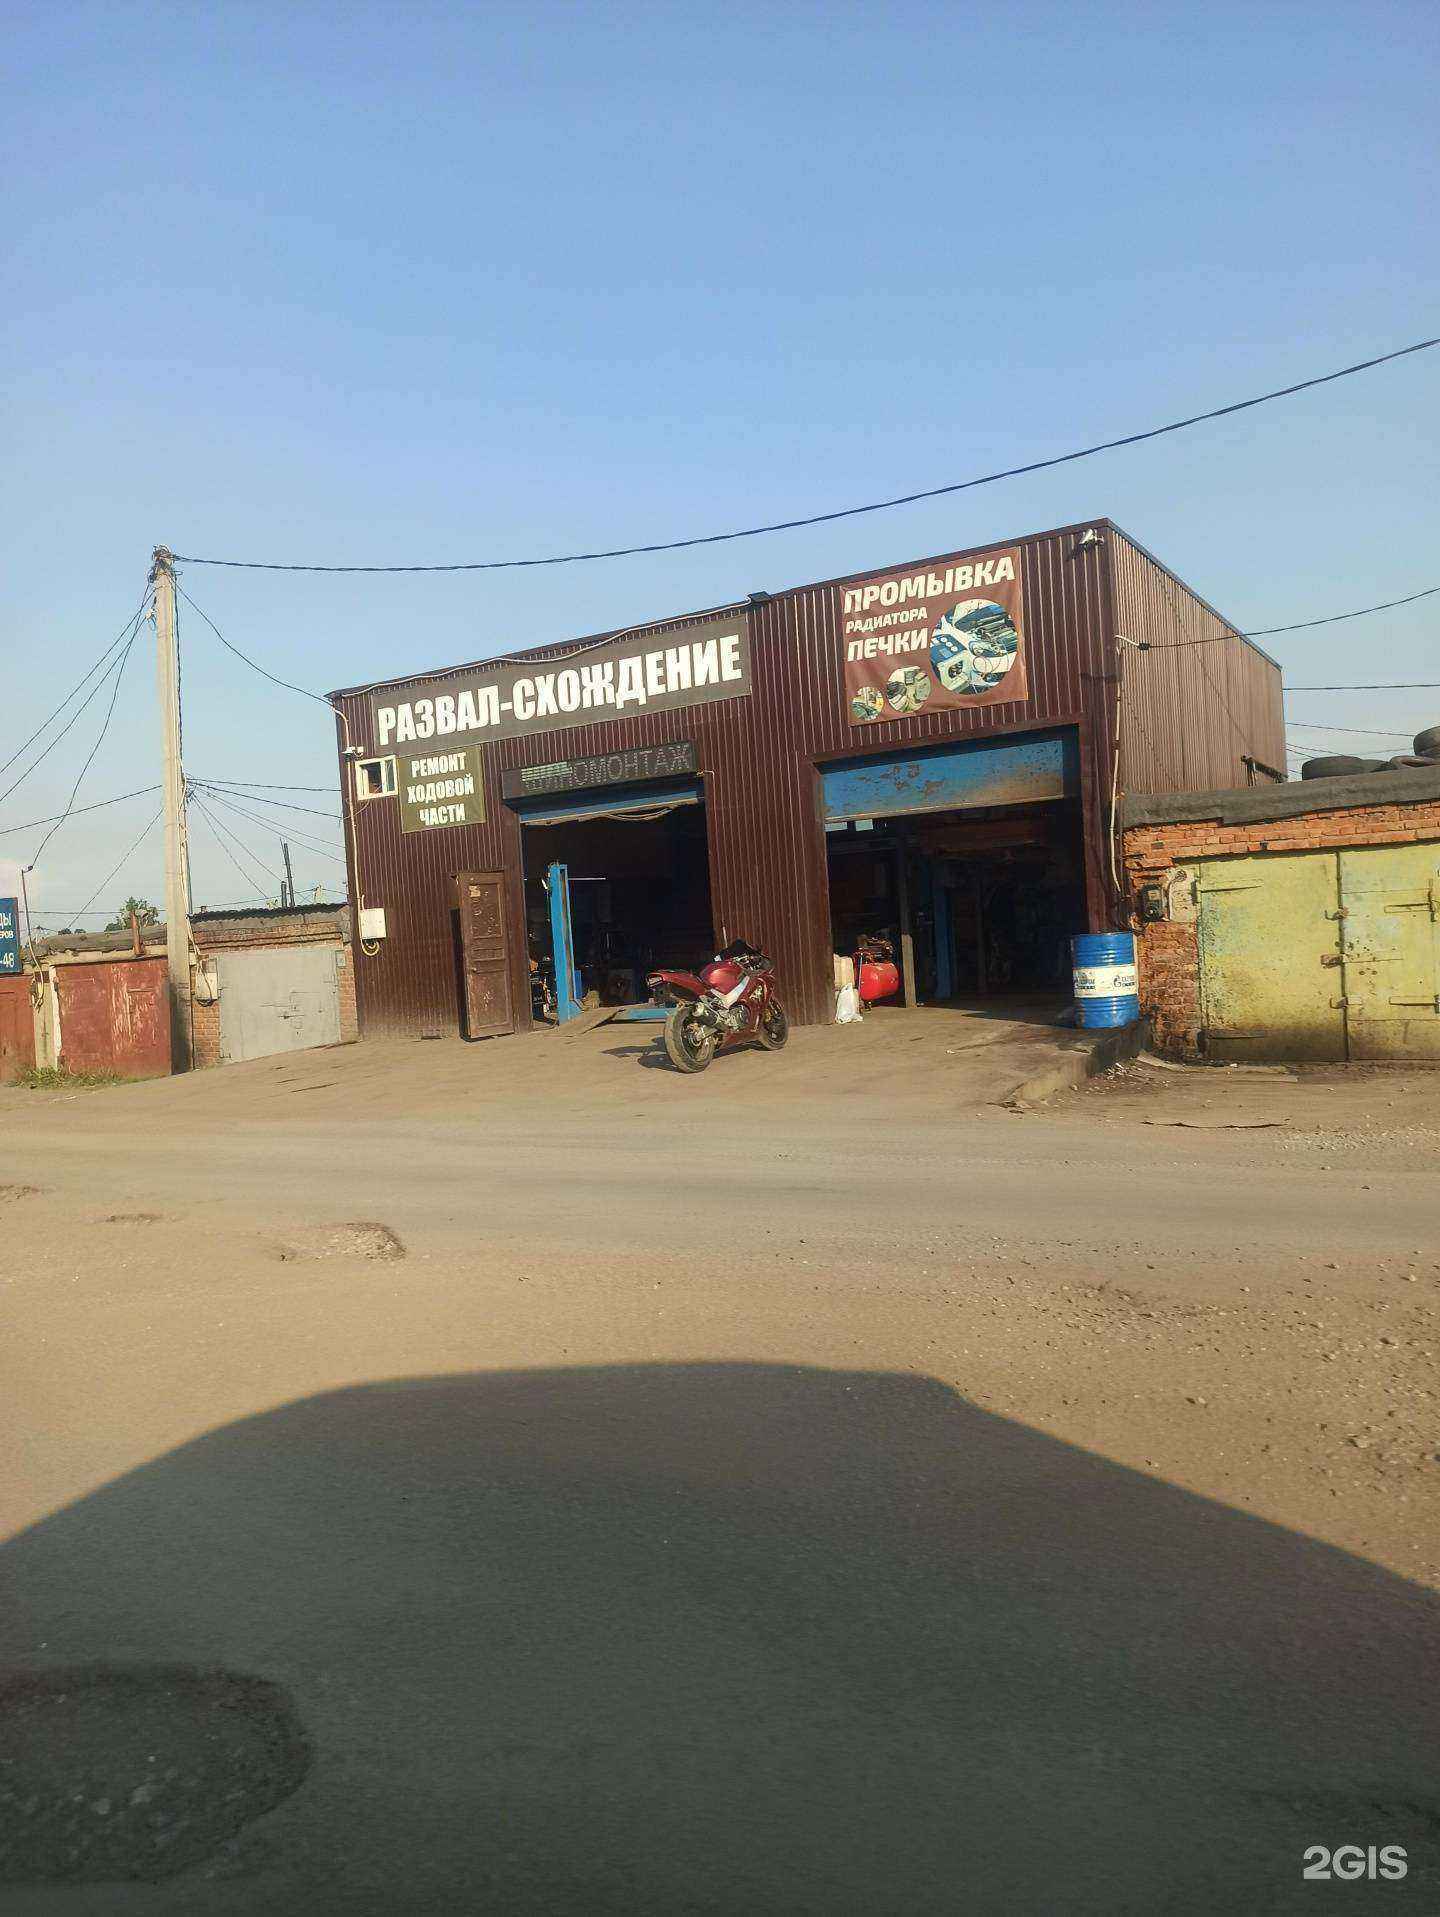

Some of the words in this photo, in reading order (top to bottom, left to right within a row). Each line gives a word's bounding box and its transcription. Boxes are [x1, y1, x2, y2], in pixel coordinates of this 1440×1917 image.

[843, 556, 1016, 614] ПРОМЫВКА
[845, 607, 929, 634] РАДИАТОРА
[847, 628, 929, 662] ПЕЧКИ
[378, 634, 743, 746] РАЗВАЛ-СХОЖДЕНИЕ
[411, 752, 467, 778] РЕМОНТ
[407, 773, 475, 804] ХОДОВОЙ
[419, 803, 466, 826] ЧАСТИ
